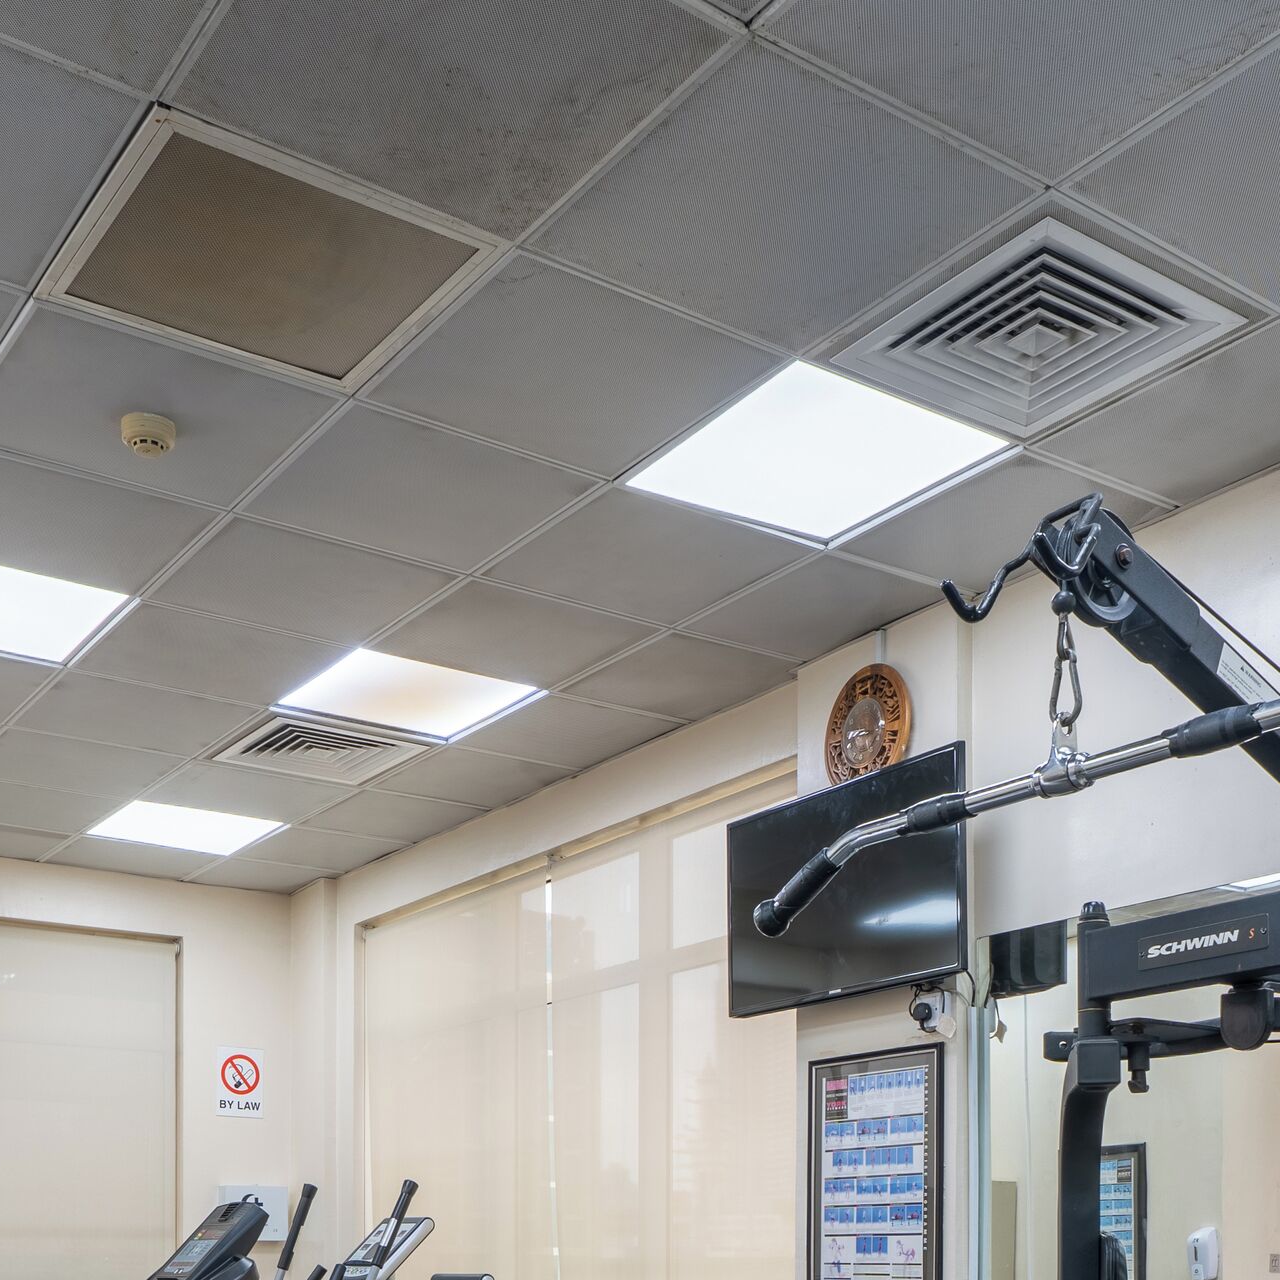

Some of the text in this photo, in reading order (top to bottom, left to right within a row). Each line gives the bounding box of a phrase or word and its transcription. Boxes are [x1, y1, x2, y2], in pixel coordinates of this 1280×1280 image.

[1146, 928, 1240, 959] SCHWINN
[219, 1099, 261, 1111] BY LAW
